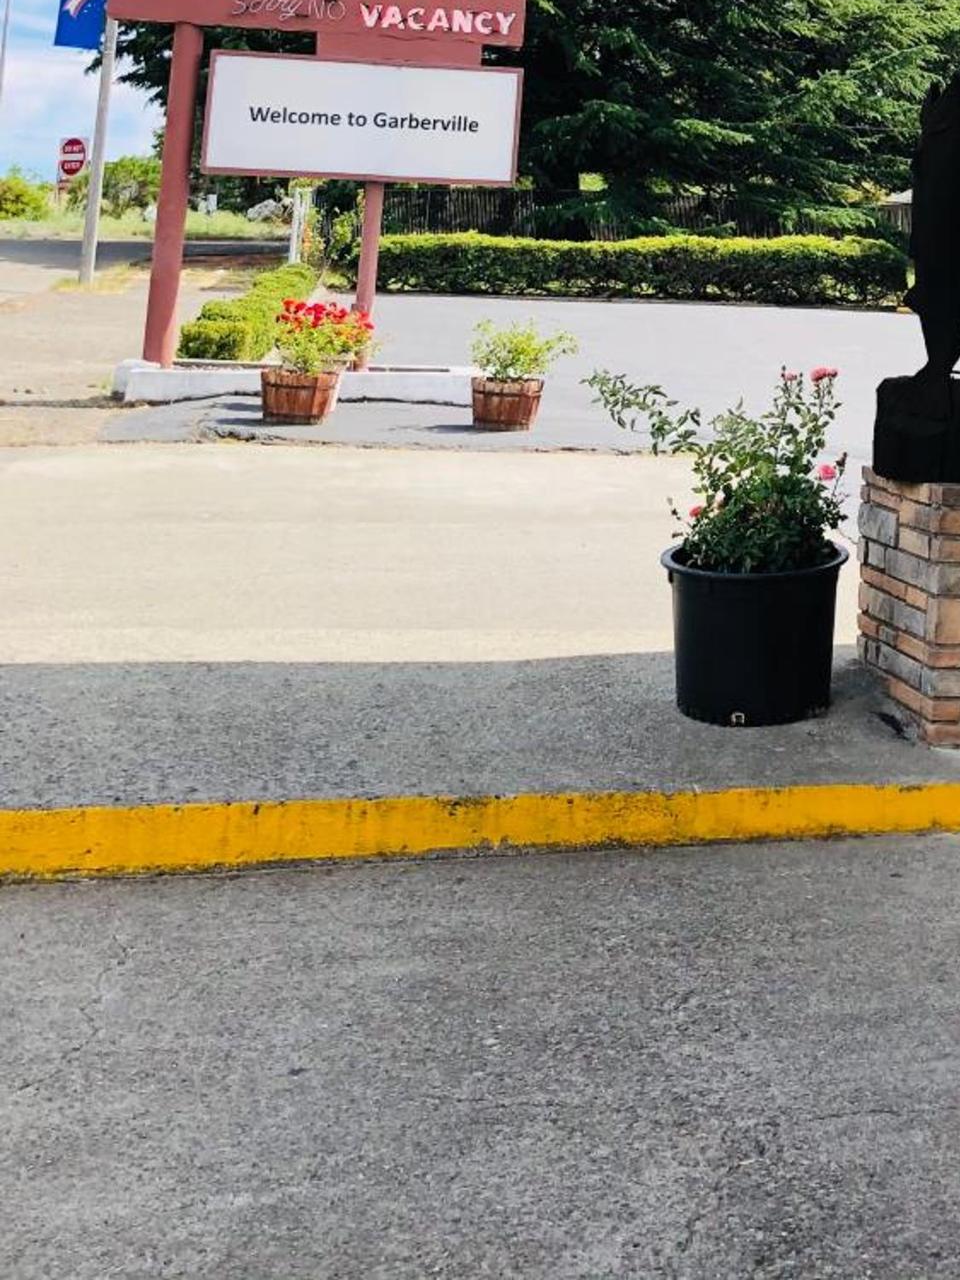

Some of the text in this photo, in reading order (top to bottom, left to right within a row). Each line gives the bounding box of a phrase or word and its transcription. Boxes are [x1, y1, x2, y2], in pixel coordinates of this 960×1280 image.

[359, 2, 517, 36] VACANCY
[249, 106, 480, 133] Welcome to Garberville
